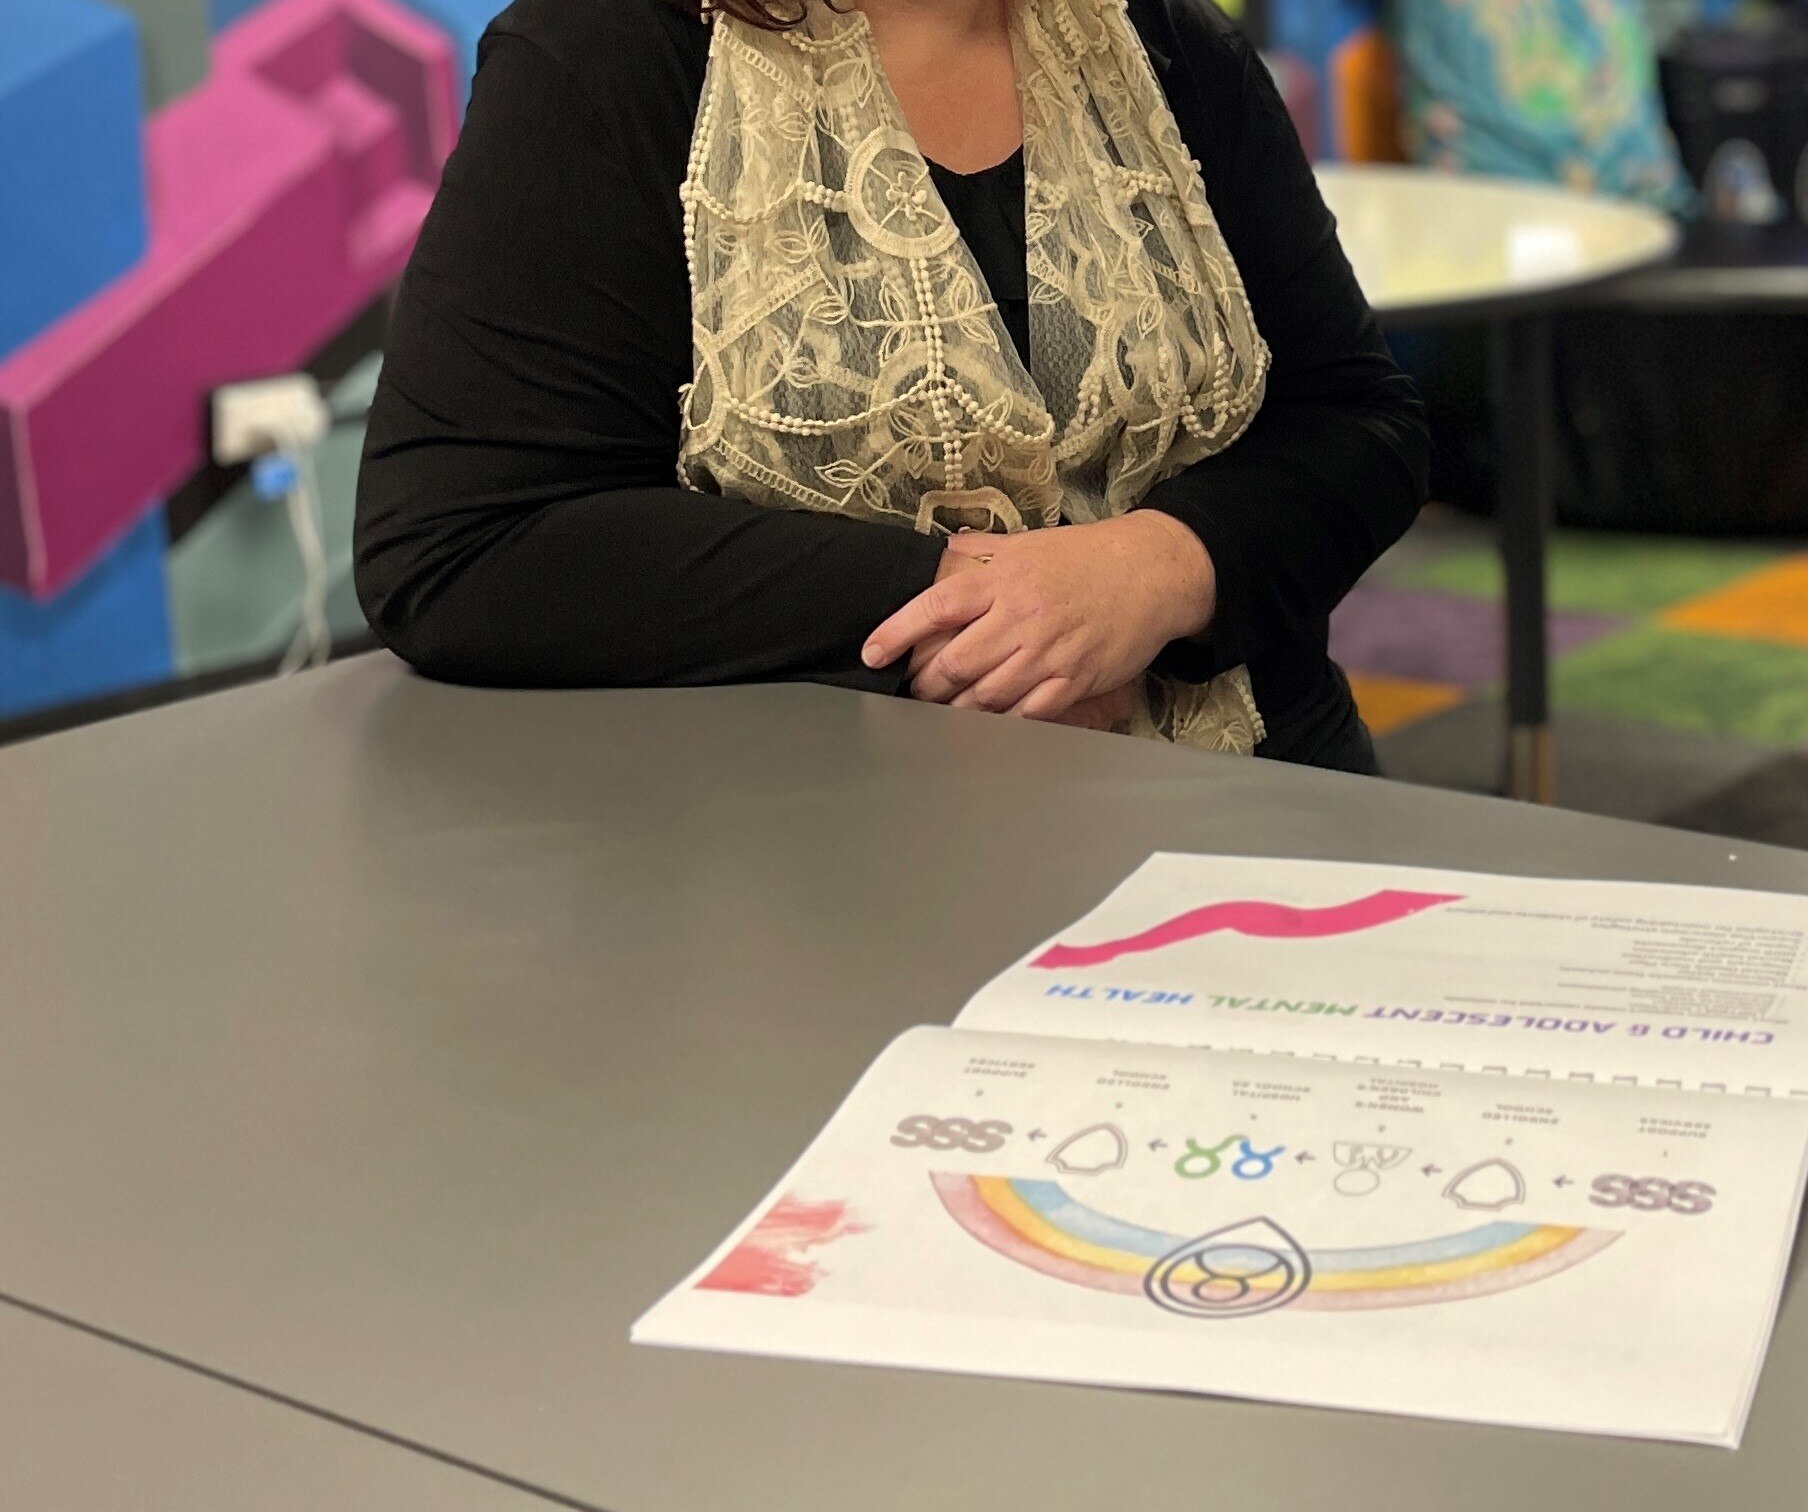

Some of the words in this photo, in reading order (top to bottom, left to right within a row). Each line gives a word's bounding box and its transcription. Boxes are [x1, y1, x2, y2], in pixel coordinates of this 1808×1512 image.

[1044, 984, 1195, 1006] HEALTH
[1208, 995, 1359, 1018] MENTAL
[1364, 1007, 1616, 1035] ADOLESCENT
[1662, 1026, 1774, 1045] CHILD
